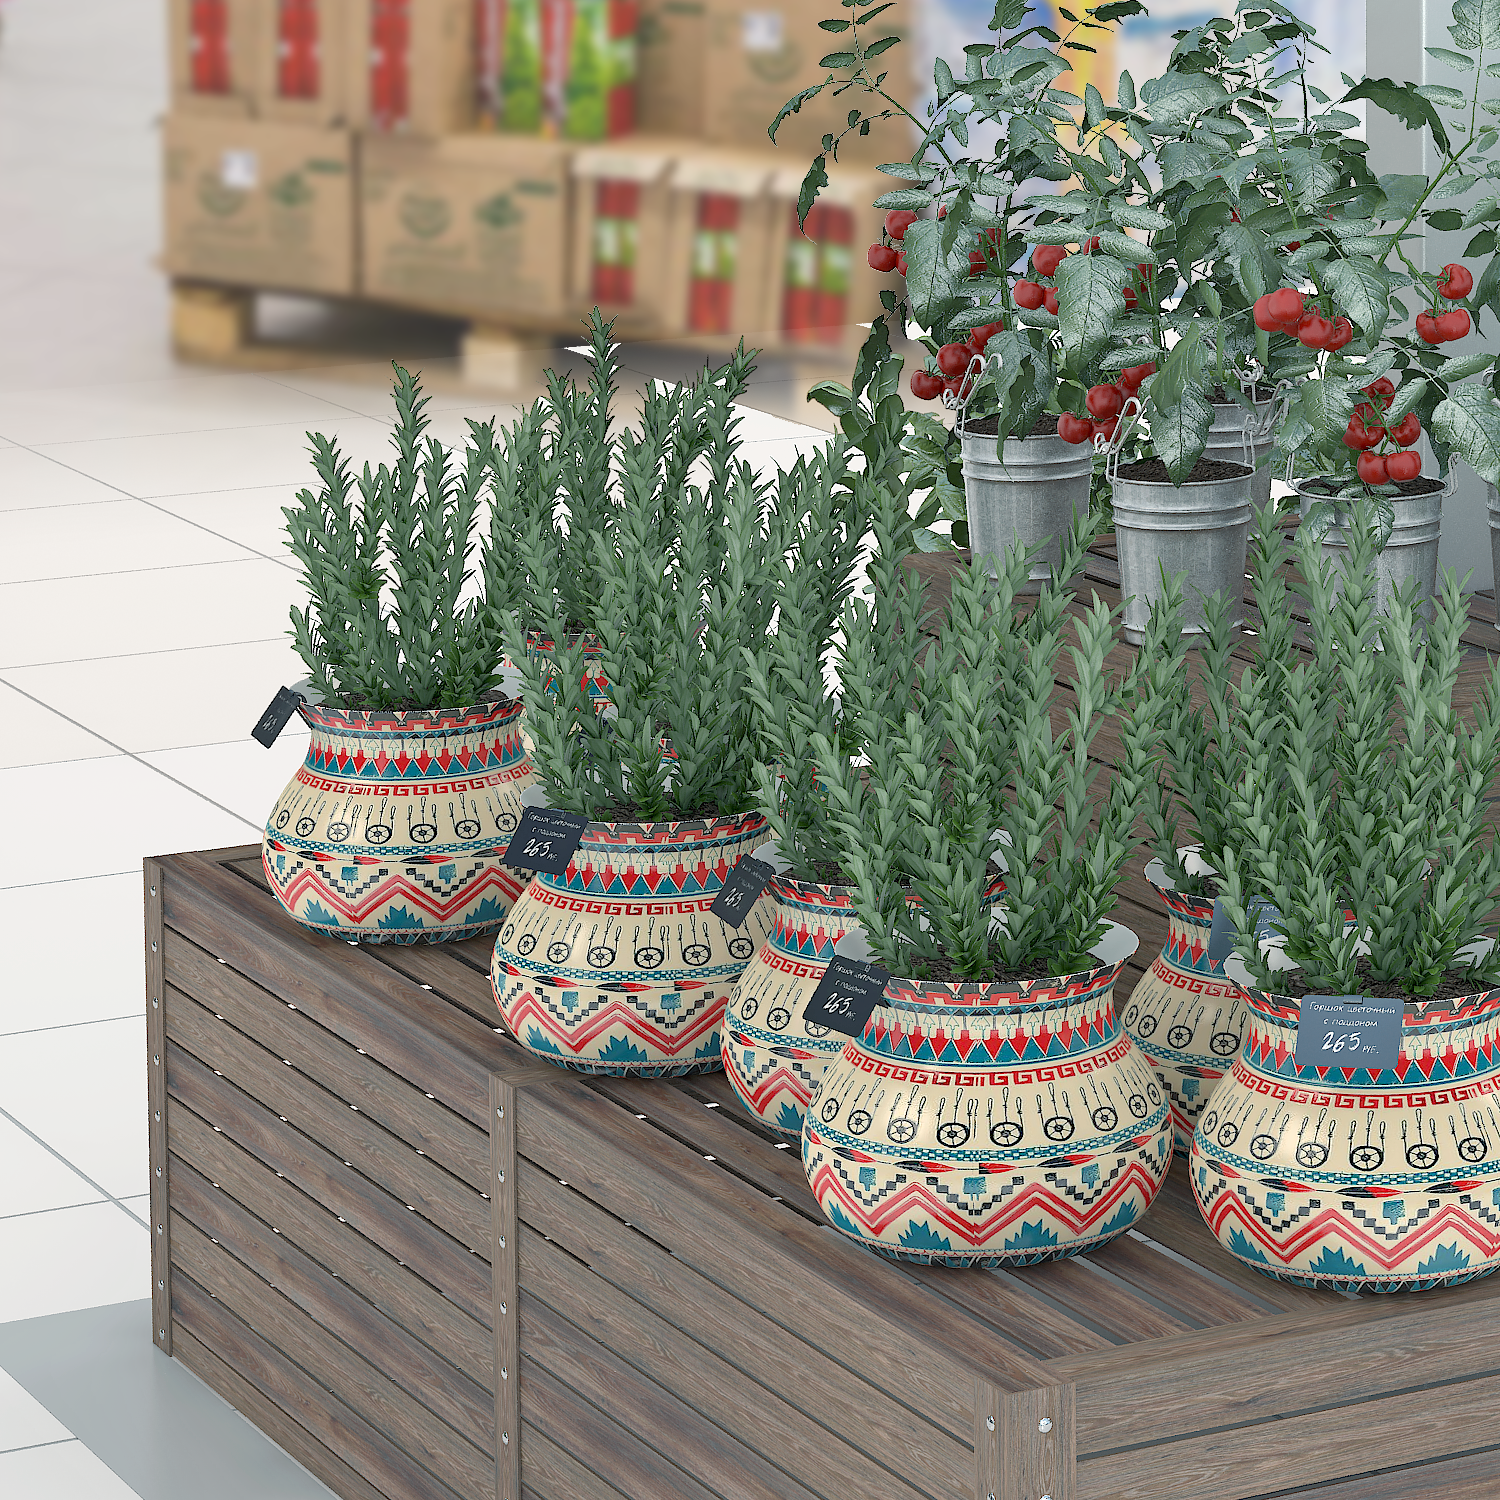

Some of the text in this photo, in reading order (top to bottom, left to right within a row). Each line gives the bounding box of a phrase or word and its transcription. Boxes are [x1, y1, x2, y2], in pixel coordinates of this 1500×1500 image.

[522, 838, 553, 857] 265
[823, 992, 854, 1014] 265
[1321, 1031, 1361, 1053] 265
